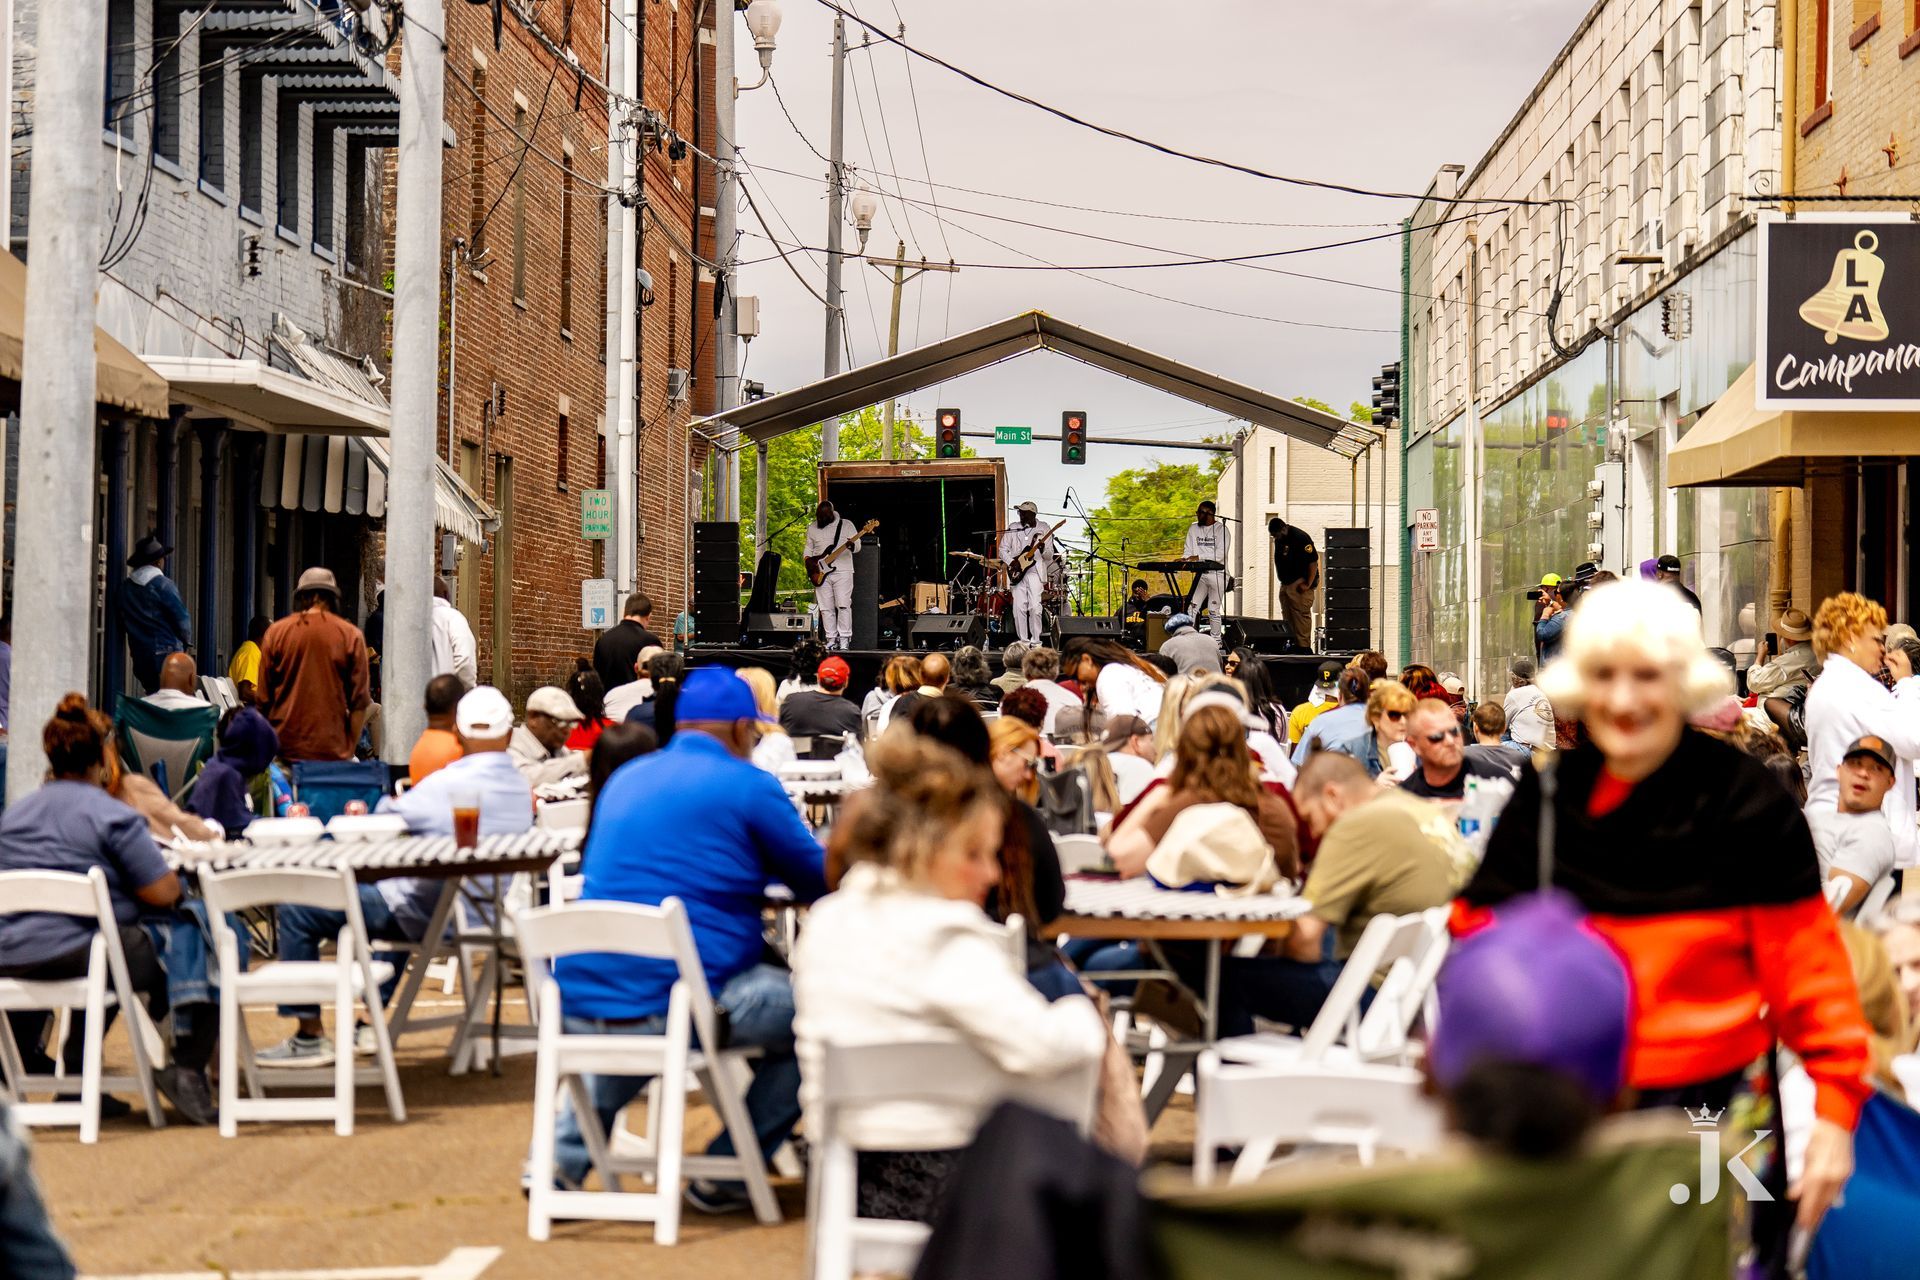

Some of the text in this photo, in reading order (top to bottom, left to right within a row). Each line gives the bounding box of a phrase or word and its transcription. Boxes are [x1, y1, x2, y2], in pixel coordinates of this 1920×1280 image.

[1845, 259, 1873, 322] LA
[1775, 343, 1920, 392] Campana
[996, 431, 1031, 440] Main St
[589, 497, 607, 505] TWO
[586, 511, 609, 519] HOUR
[1422, 512, 1432, 521] NO
[585, 524, 610, 532] PARKING
[1323, 670, 1331, 680] P
